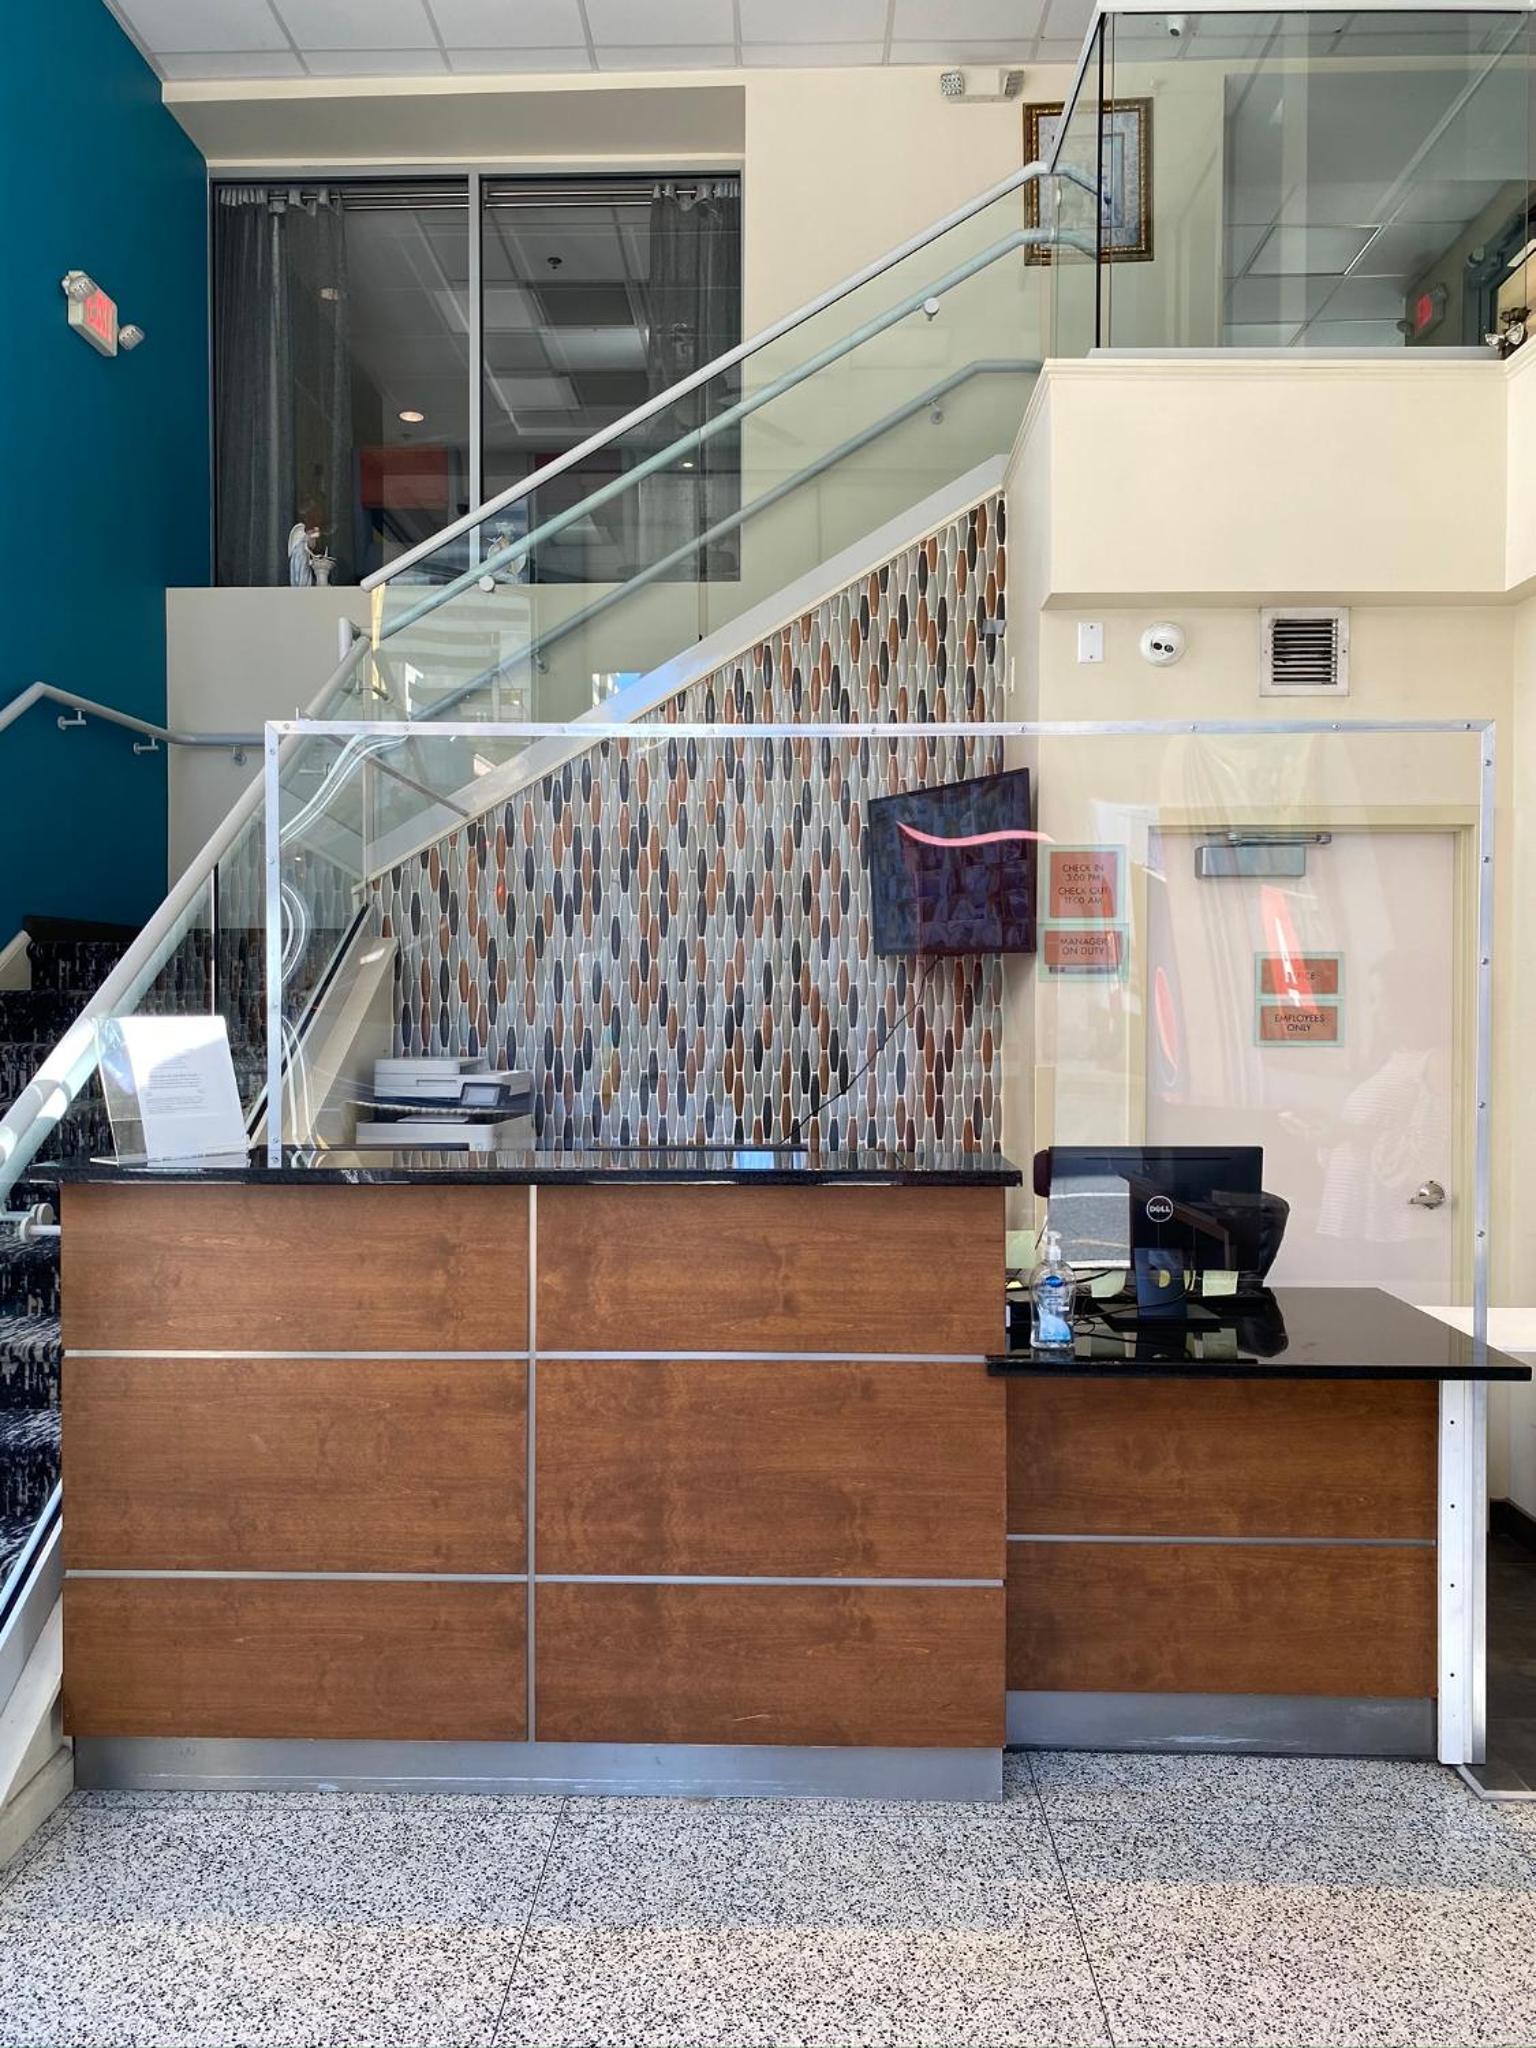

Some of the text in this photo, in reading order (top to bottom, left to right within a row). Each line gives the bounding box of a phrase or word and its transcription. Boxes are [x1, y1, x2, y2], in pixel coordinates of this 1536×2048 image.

[1062, 863, 1104, 873] CHECK IN
[1065, 873, 1101, 882] 3:00 PM
[1058, 886, 1111, 896] CHECK OUT
[1087, 896, 1103, 905] AM
[1060, 937, 1110, 946] MANAGER
[1062, 946, 1105, 956] ON DUTY
[1274, 1014, 1326, 1024] EMPLOYEES
[1286, 1023, 1311, 1032] ONLY
[1149, 1205, 1171, 1213] DELL
